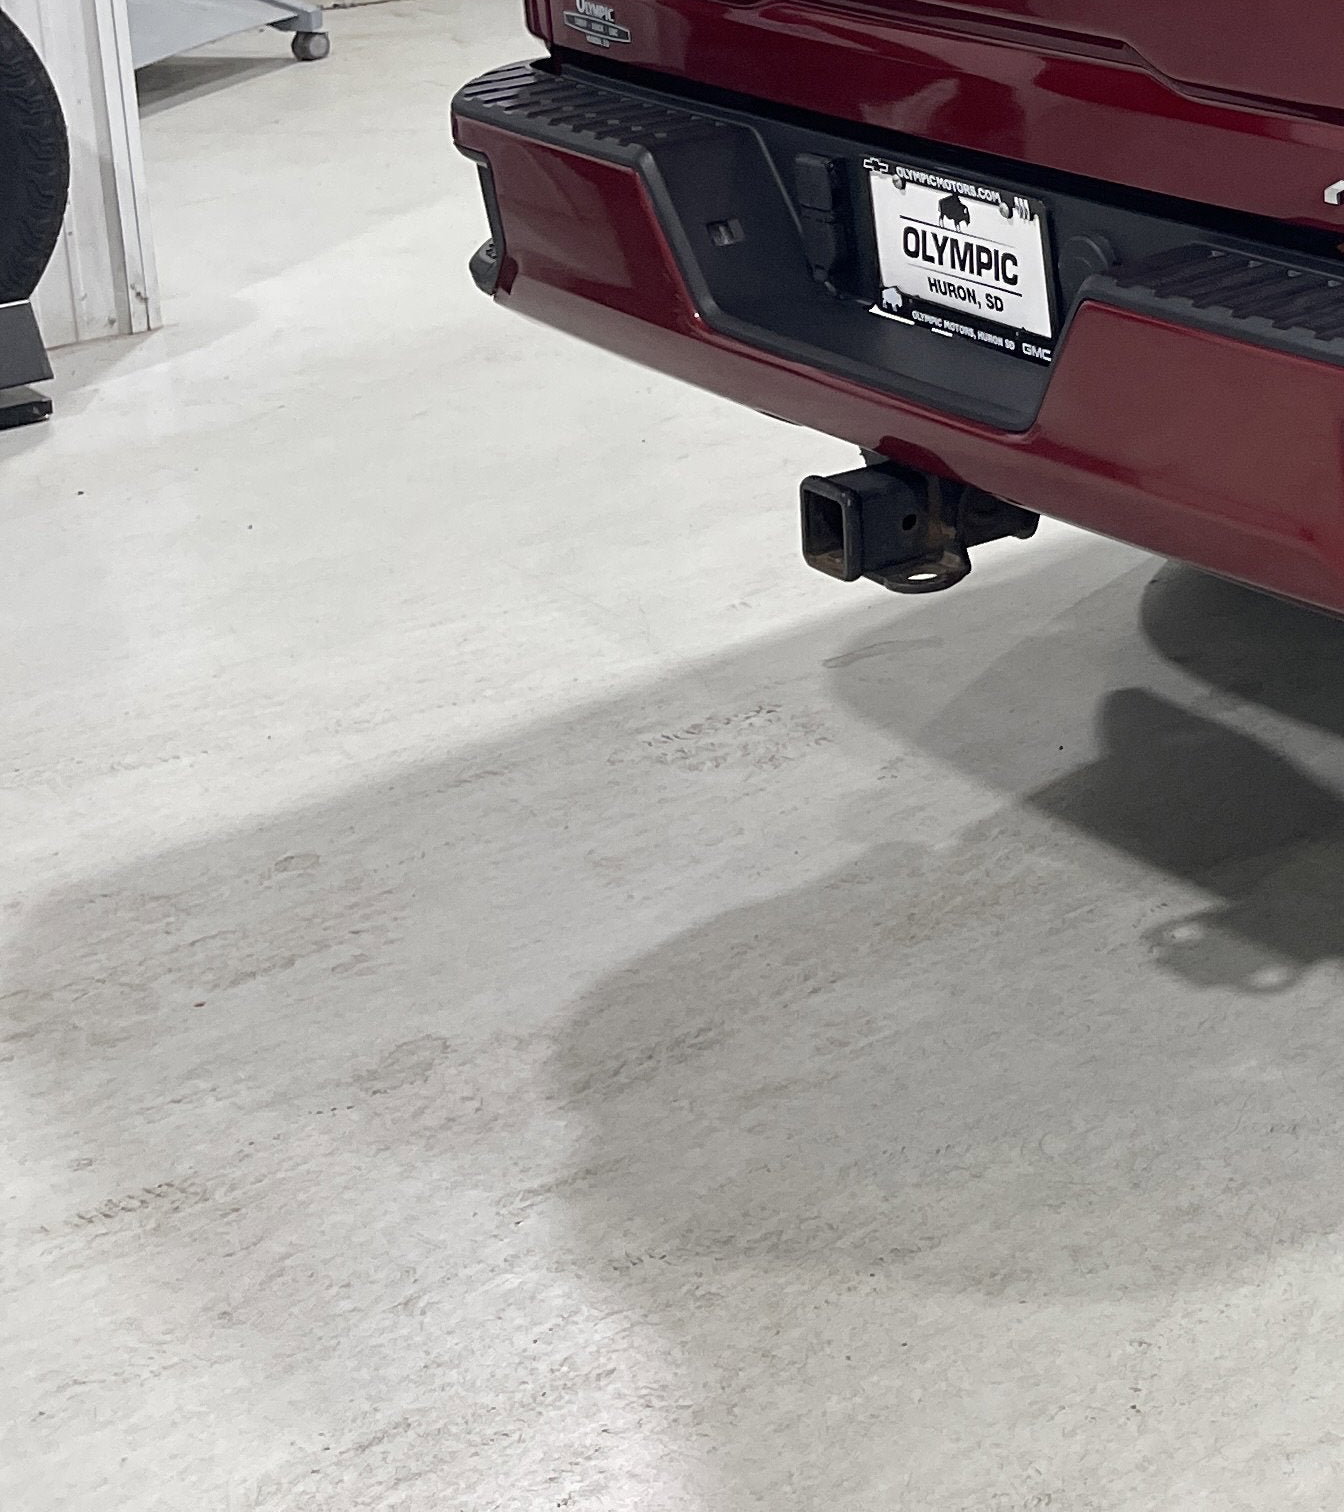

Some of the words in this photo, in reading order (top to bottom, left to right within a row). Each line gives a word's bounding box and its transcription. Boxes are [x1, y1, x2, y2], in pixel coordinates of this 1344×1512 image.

[896, 166, 1002, 203] OLYMPICMOTORS.COM
[903, 226, 1019, 286] OLYMPIC
[928, 277, 981, 309] HURON,
[986, 293, 1004, 312] SD
[912, 310, 943, 328] OLYMPIC
[1022, 343, 1052, 362] GMC
